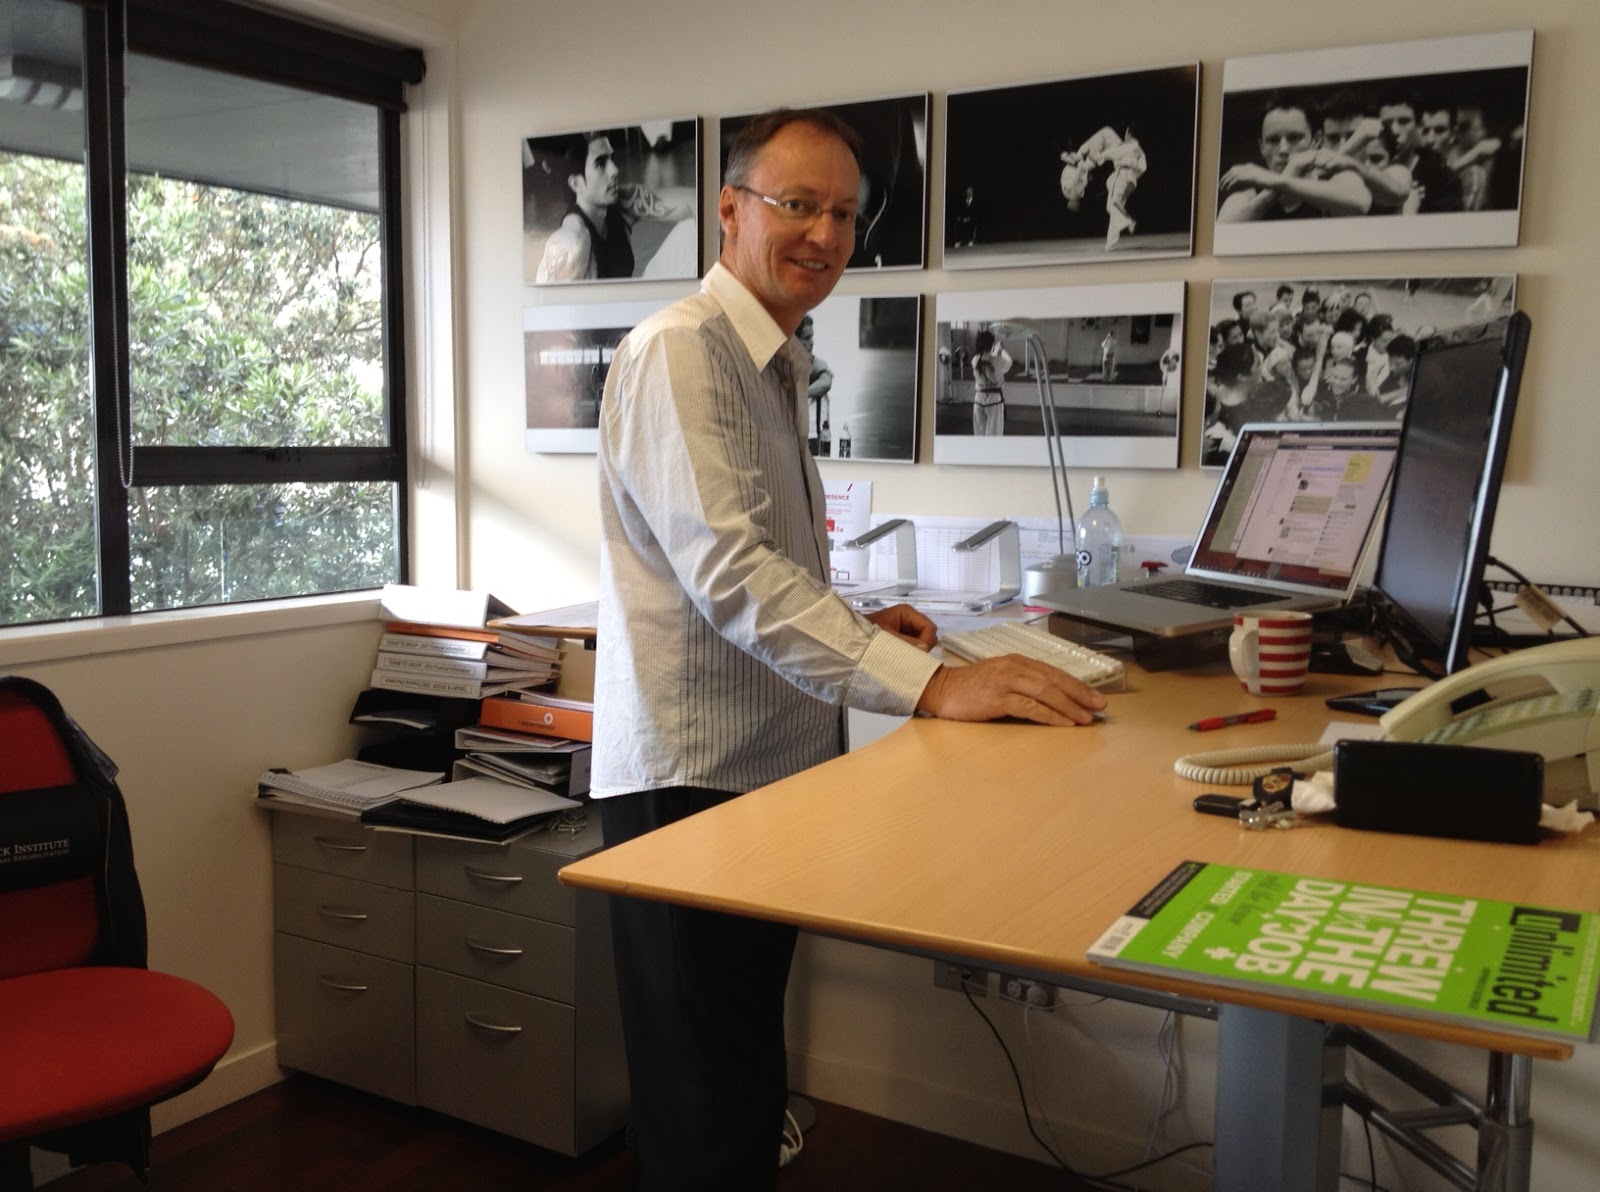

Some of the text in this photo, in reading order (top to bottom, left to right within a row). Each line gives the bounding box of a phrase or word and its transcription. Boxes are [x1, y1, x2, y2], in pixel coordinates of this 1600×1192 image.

[15, 839, 70, 853] INSTITUTE
[1207, 870, 1254, 904] STARTED
[1158, 910, 1218, 959] COMPANY
[1230, 878, 1345, 976] DAY JOB
[1290, 885, 1412, 989] IN THE
[1367, 897, 1477, 1001] THREW
